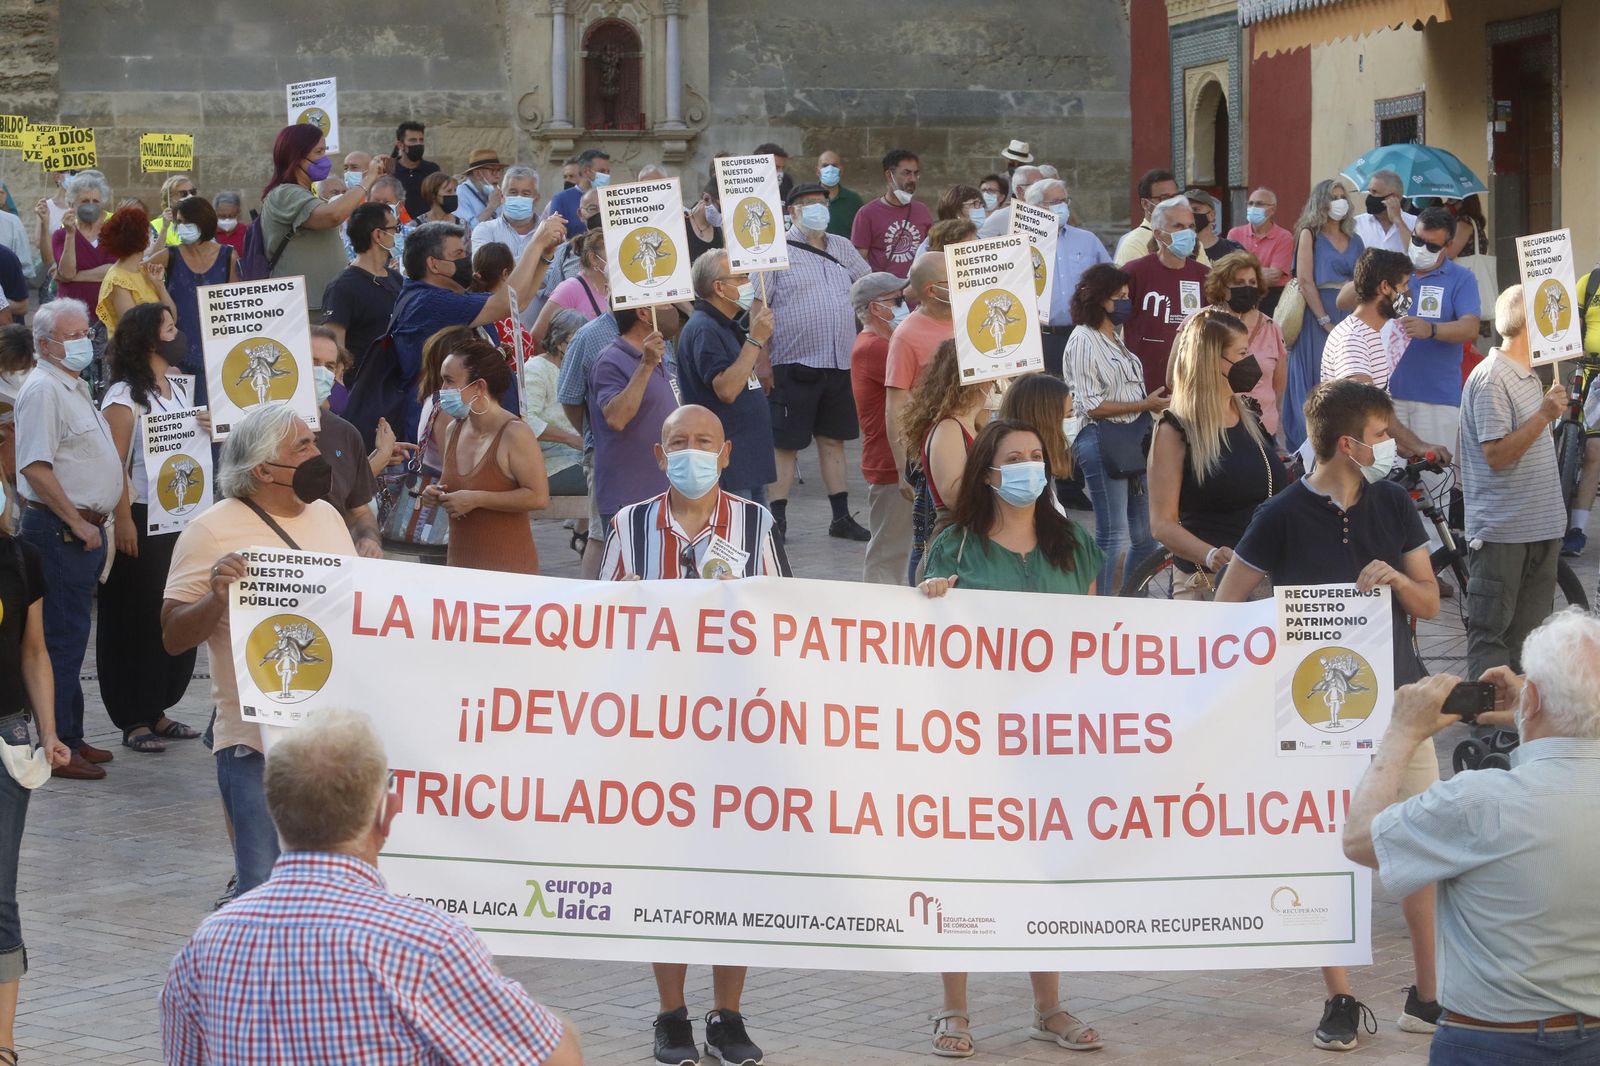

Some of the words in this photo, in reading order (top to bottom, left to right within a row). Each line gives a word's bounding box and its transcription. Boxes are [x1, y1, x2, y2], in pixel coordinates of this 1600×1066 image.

[291, 80, 331, 90] RECUPEREMOS
[292, 93, 326, 101] PATRIMONIO
[59, 129, 93, 145] DIOS
[44, 156, 59, 169] de
[63, 152, 96, 167] DIOS
[722, 158, 769, 167] RECUPEREMOS
[723, 168, 753, 176] NUESTRO
[724, 176, 765, 185] PATRIMONIO
[606, 183, 672, 197] RECUPEREMOS
[725, 186, 754, 194] PÚBLICO
[608, 196, 648, 207] NUESTRO
[609, 204, 665, 217] PATRIMONIO
[1016, 204, 1055, 221] RECUPEREMOS
[610, 215, 649, 227] PÚBLICO
[1016, 213, 1040, 225] NUESTRO
[1015, 222, 1048, 237] PATRIMONIO
[954, 238, 1022, 256] RECUPEREMOS
[1523, 234, 1566, 248] RECUPEREMOS
[1525, 247, 1552, 258] NUESTRO
[956, 253, 998, 267] NUESTRO
[1526, 255, 1562, 268] PATRIMONIO
[957, 262, 1014, 278] PATRIMONIO
[1527, 266, 1552, 278] PÚBLICO
[958, 276, 998, 290] PÚBLICO
[208, 282, 295, 299] RECUPEREMOS
[209, 298, 264, 312] NUESTRO
[211, 308, 285, 324] PATRIMONIO
[212, 323, 263, 336] PÚBLICO
[148, 422, 182, 434] NUESTRO
[149, 430, 195, 444] PATRIMONIO
[149, 443, 182, 454] PÚBLICO
[239, 581, 327, 595] PATRIMONIO
[1285, 588, 1381, 599] RECUPEREMOS
[239, 594, 299, 608] PÚBLICO
[1286, 603, 1345, 612] NUESTRO
[1286, 616, 1368, 626] PATRIMONIO
[352, 591, 414, 639] LA
[432, 598, 681, 652] MEZQUITA
[696, 608, 757, 656] ES
[773, 614, 1053, 673] PATRIMONIO
[1070, 622, 1277, 676] PÚBLICO
[1287, 629, 1342, 640] PÚBLICO
[458, 687, 807, 745] ¡¡DEVOLUCIÓN
[824, 703, 879, 750] DE
[896, 708, 981, 755] LOS
[998, 713, 1173, 756] BIENES
[713, 784, 814, 833] POR
[829, 790, 883, 836] LA
[897, 794, 1074, 841] IGLESIA
[545, 880, 612, 898] europa
[473, 900, 517, 916] LAICA
[557, 898, 611, 921] laica
[634, 908, 737, 926] PLATAFORMA
[743, 913, 904, 932] MEZQUITA-CATEDRAL
[1027, 920, 1147, 934] COORDINADORA
[1151, 916, 1264, 933] RECUPERANDO
